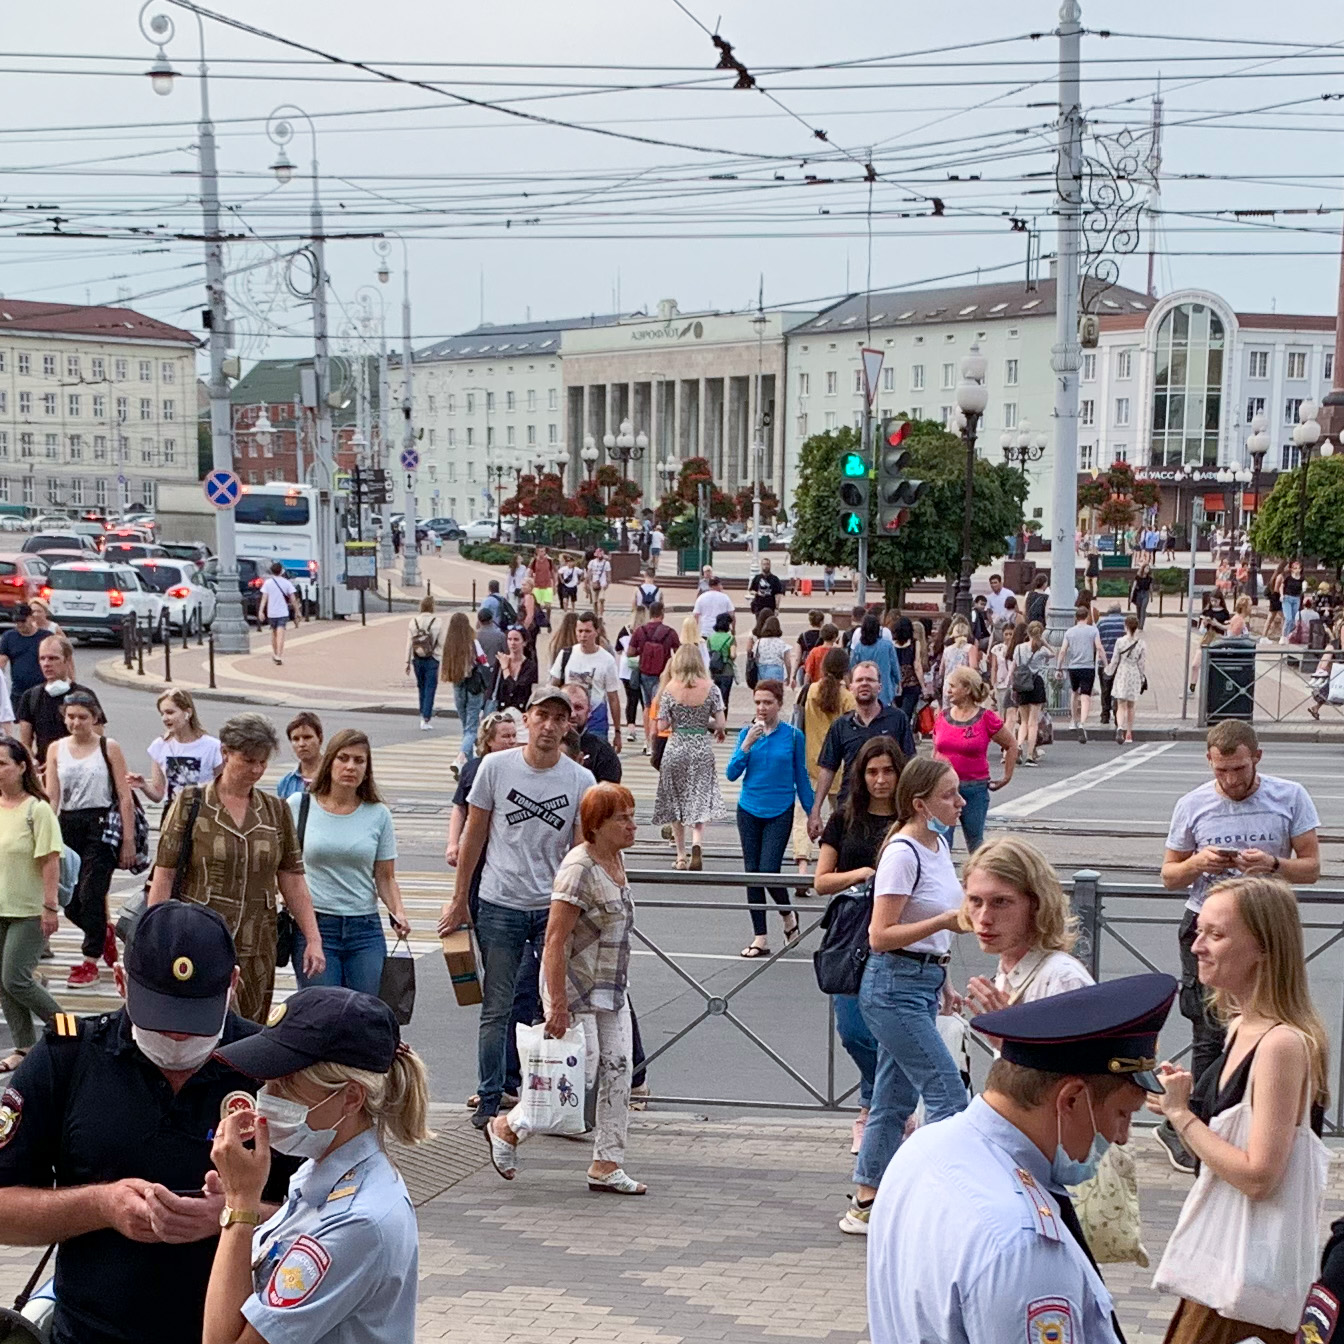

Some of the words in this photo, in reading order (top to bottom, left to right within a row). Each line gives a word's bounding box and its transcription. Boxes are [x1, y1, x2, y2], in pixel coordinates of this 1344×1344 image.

[513, 793, 544, 816] TOMMY
[542, 811, 562, 827] LIFE
[540, 797, 567, 811] OUTH
[1207, 833, 1274, 845] TROPICAL
